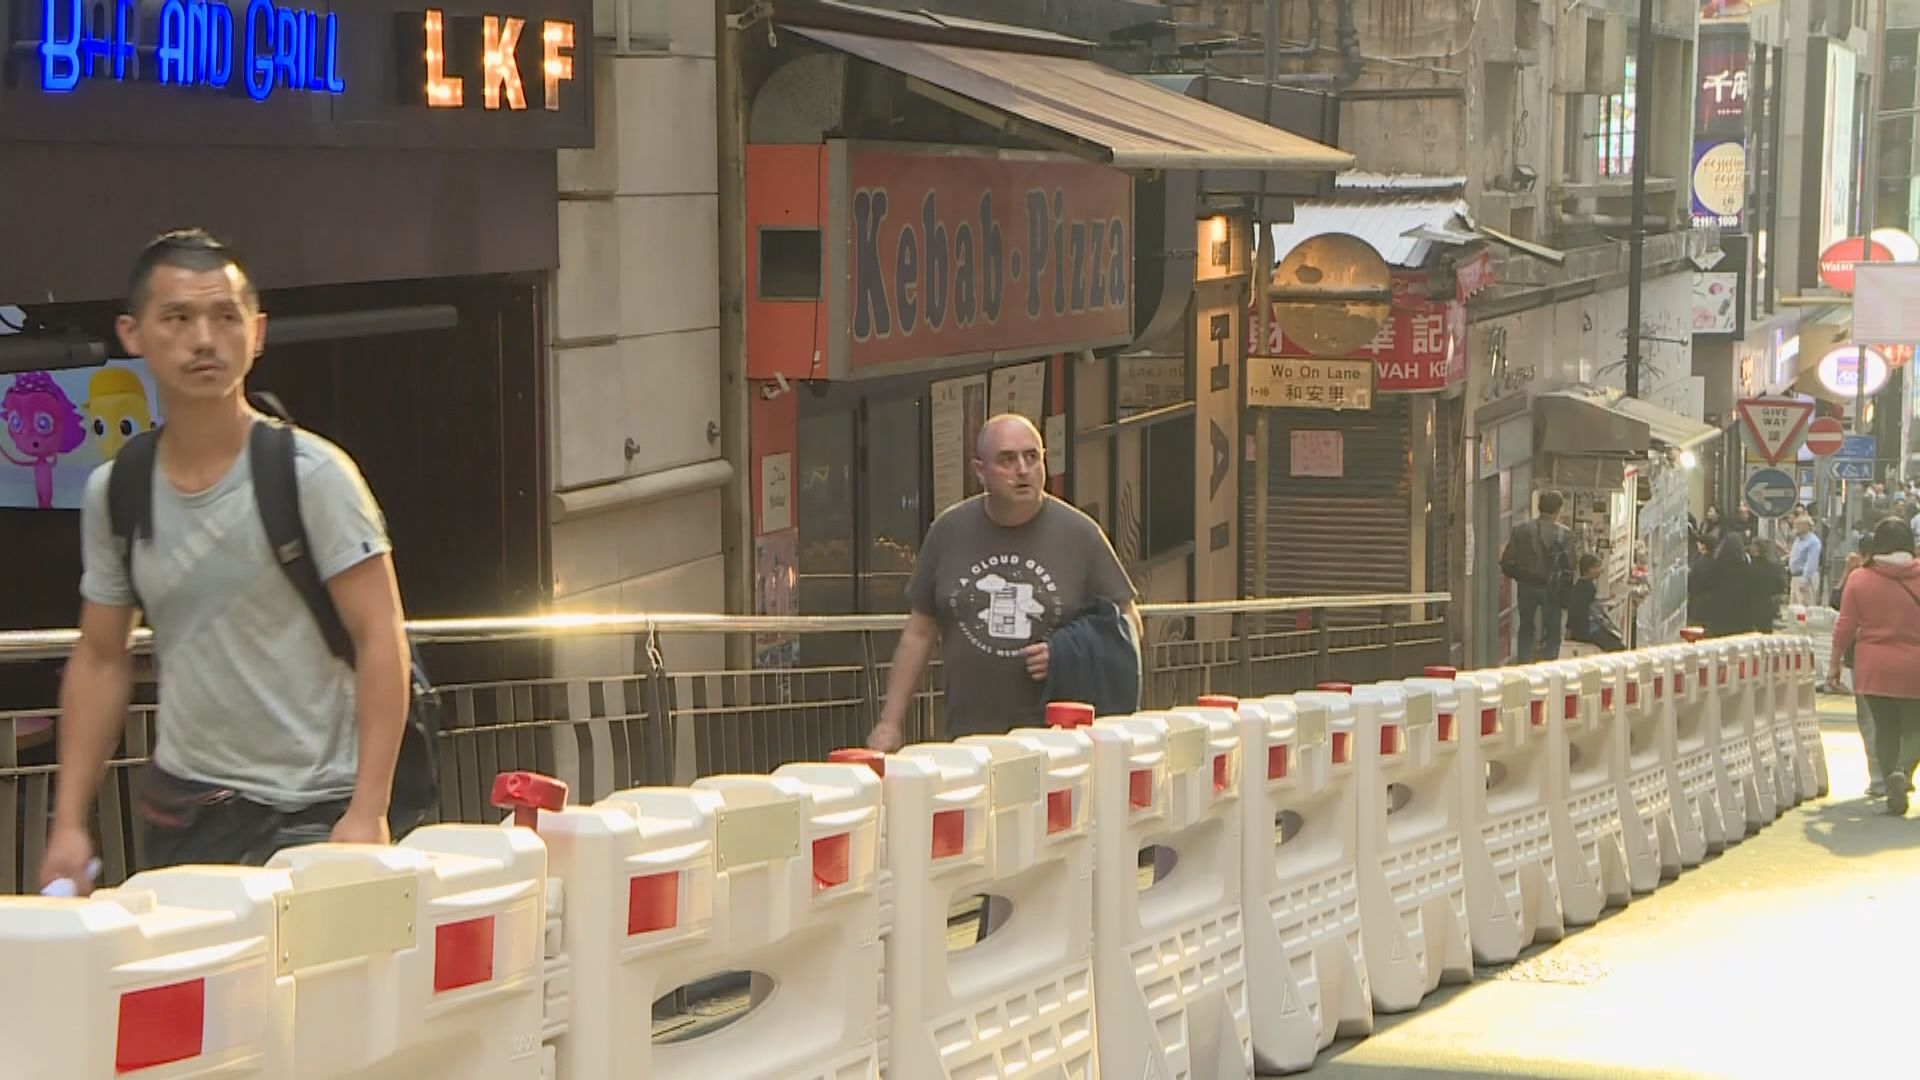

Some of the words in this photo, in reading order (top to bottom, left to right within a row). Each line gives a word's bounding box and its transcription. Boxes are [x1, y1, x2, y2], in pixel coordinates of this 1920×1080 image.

[157, 0, 233, 87] AND
[245, 0, 345, 101] GRILL
[1271, 364, 1292, 377] Wo
[1300, 365, 1320, 379] On
[1327, 366, 1361, 379] Lane
[1762, 408, 1788, 416] GIVE
[1763, 418, 1787, 426] WAY
